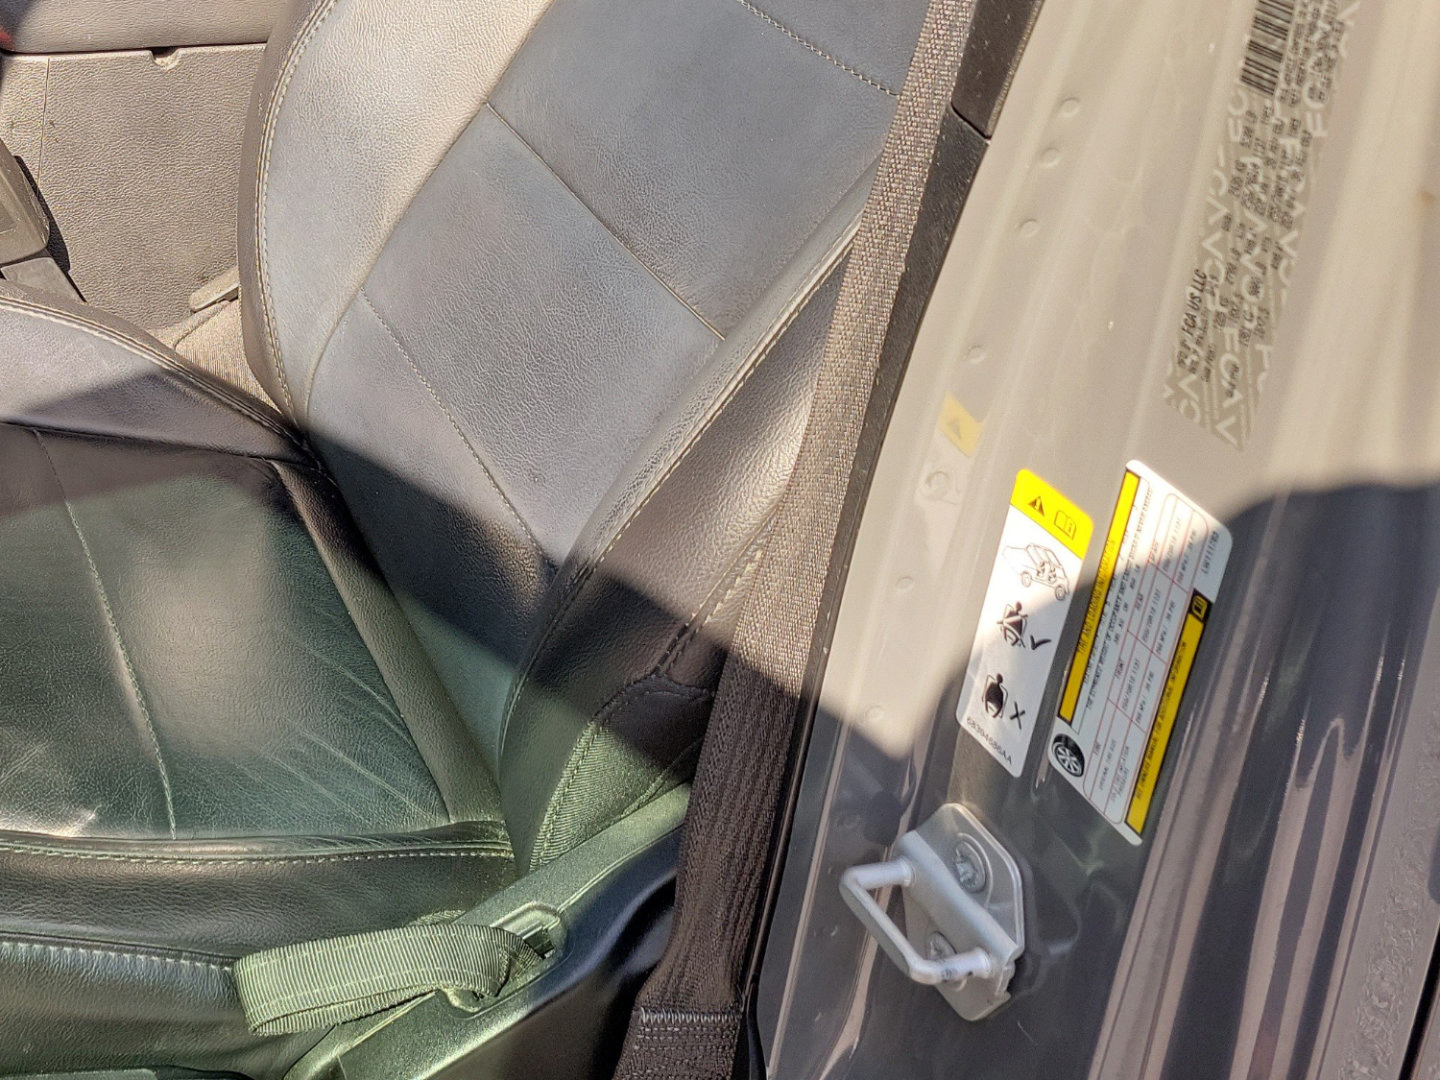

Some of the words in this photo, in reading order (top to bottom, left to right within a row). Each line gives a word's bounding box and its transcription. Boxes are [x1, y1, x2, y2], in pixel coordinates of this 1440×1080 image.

[1191, 266, 1207, 292] LLC
[1187, 290, 1201, 311] US
[1181, 309, 1196, 336] FCA
